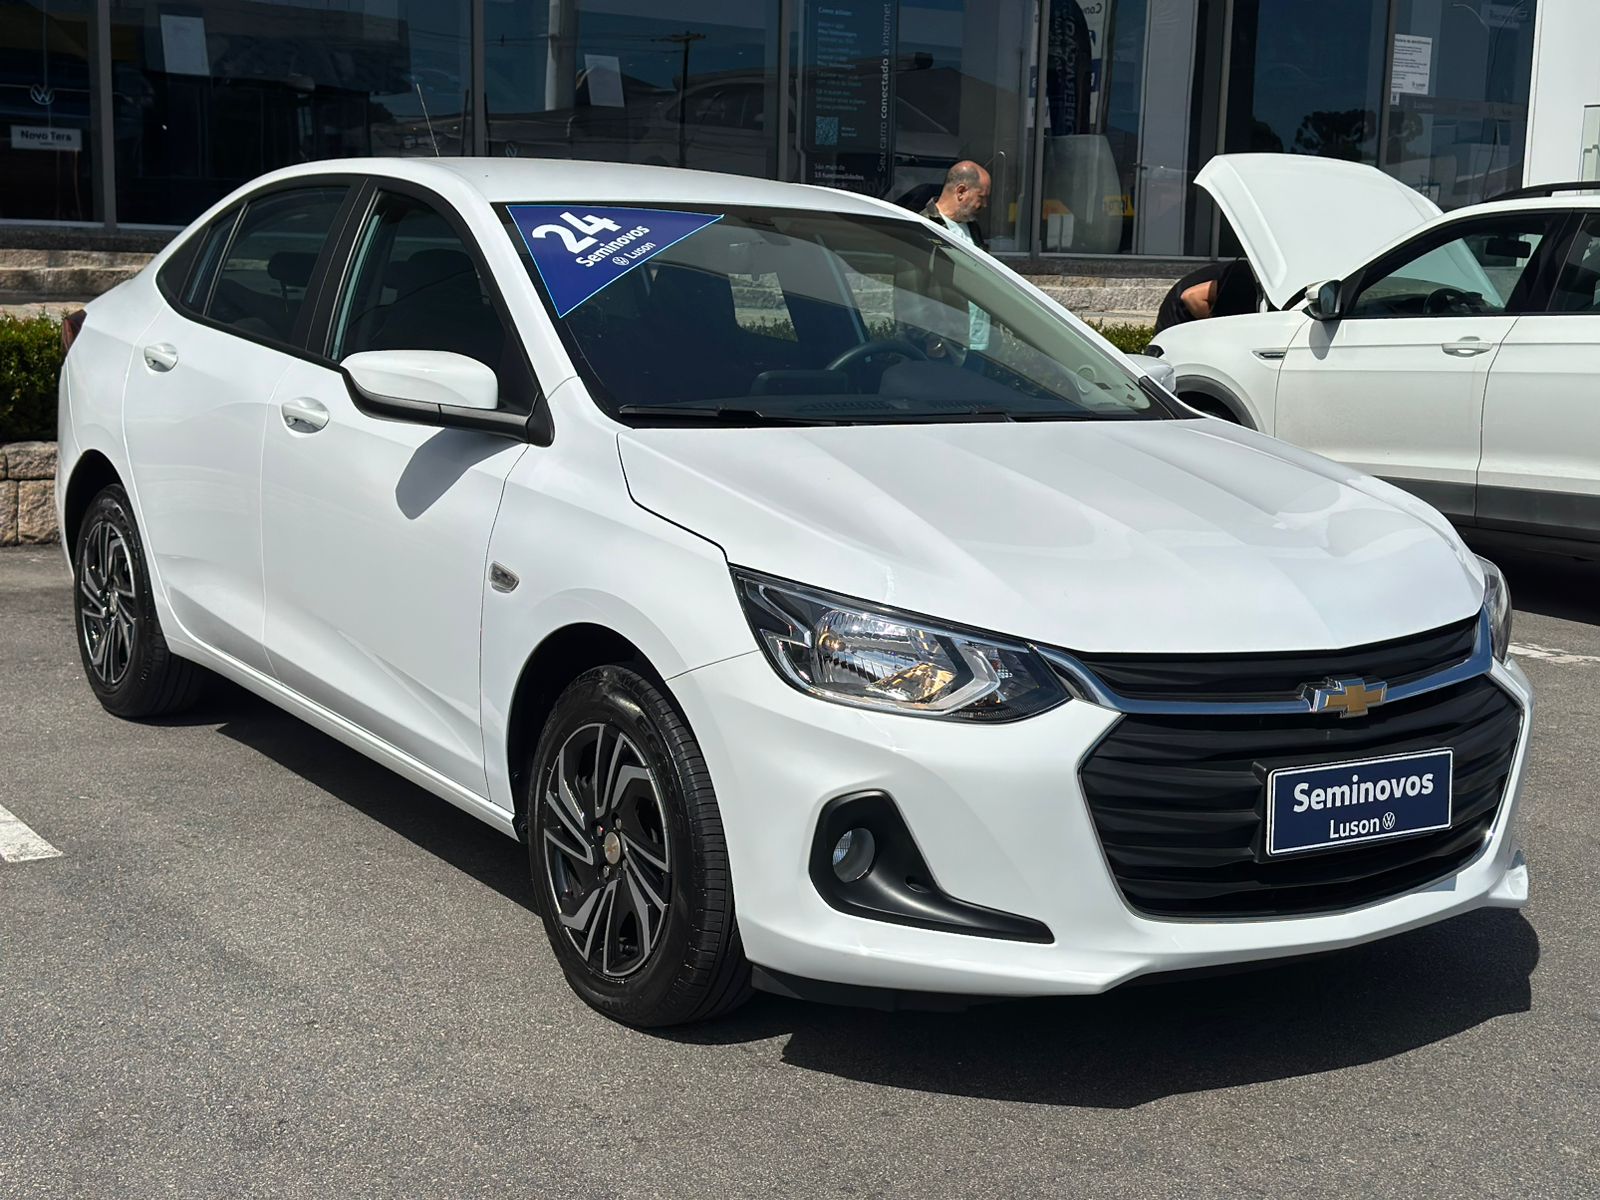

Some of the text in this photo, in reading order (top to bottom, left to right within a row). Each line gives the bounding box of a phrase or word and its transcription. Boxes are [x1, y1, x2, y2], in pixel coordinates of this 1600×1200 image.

[882, 3, 891, 46] internet
[880, 58, 889, 119] conectado
[21, 130, 72, 141] Novo Tera
[532, 211, 622, 254] 24
[575, 225, 650, 267] Seminovos
[624, 241, 656, 260] Luson
[1293, 773, 1434, 813] Seminovos
[1329, 817, 1380, 839] Luson
